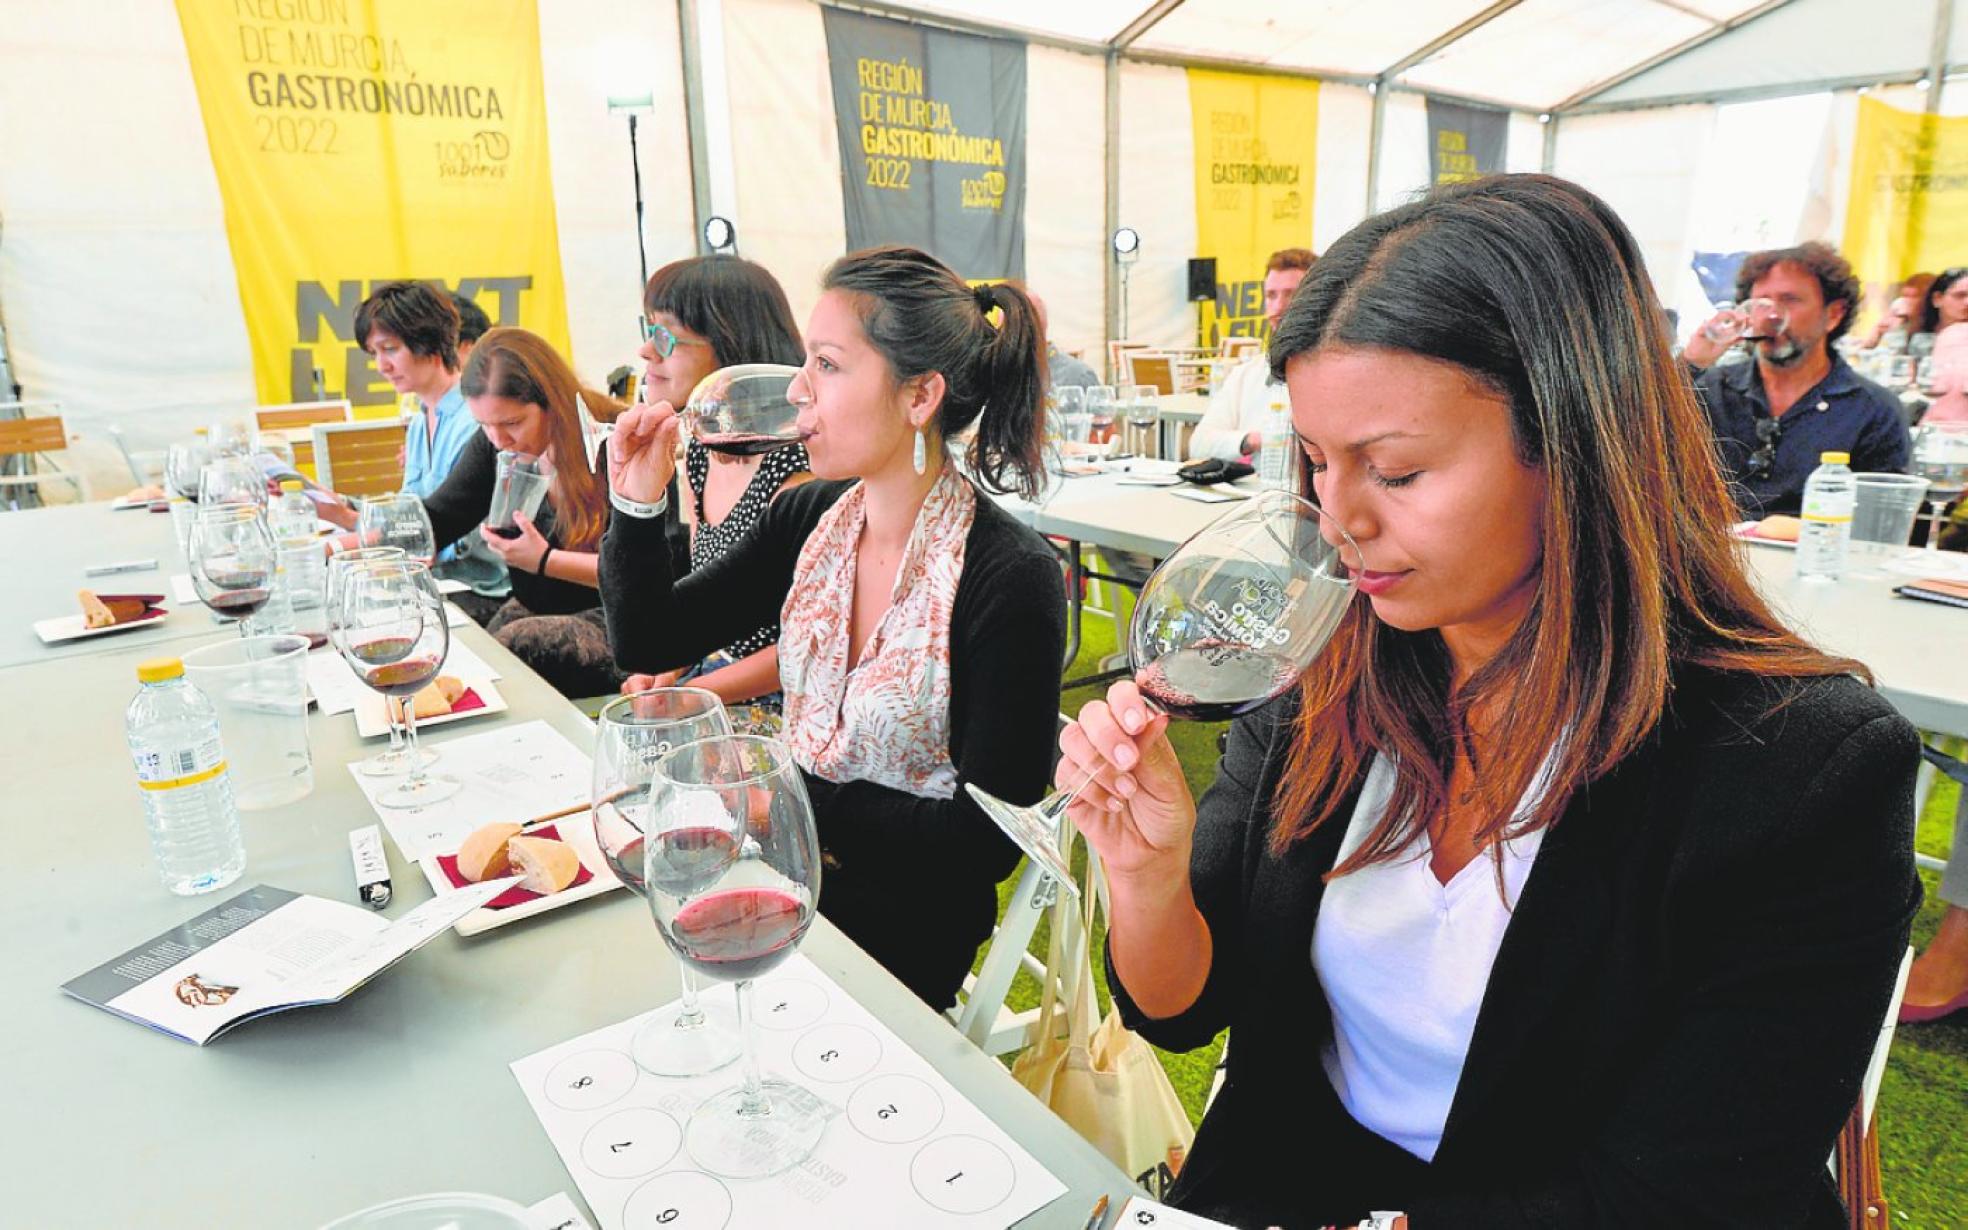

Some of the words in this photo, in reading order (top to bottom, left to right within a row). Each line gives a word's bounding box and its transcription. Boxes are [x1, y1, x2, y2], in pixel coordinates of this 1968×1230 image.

[239, 25, 279, 64] DE
[288, 29, 409, 74] MURCIA
[858, 58, 923, 95] REGIÓN
[247, 70, 504, 120] GASTRONÓMICA
[860, 92, 883, 122] DE
[887, 96, 953, 129] MURCIA
[255, 116, 342, 155] 2022
[862, 124, 1004, 166] GASTRONÓMICA
[865, 158, 911, 190] 2022
[1211, 158, 1300, 185] GASTRONÓMICA
[820, 1050, 839, 1062] 3
[572, 1075, 593, 1089] 8
[877, 1104, 898, 1119] 2
[610, 1141, 632, 1153] 7
[946, 1170, 963, 1185] 1
